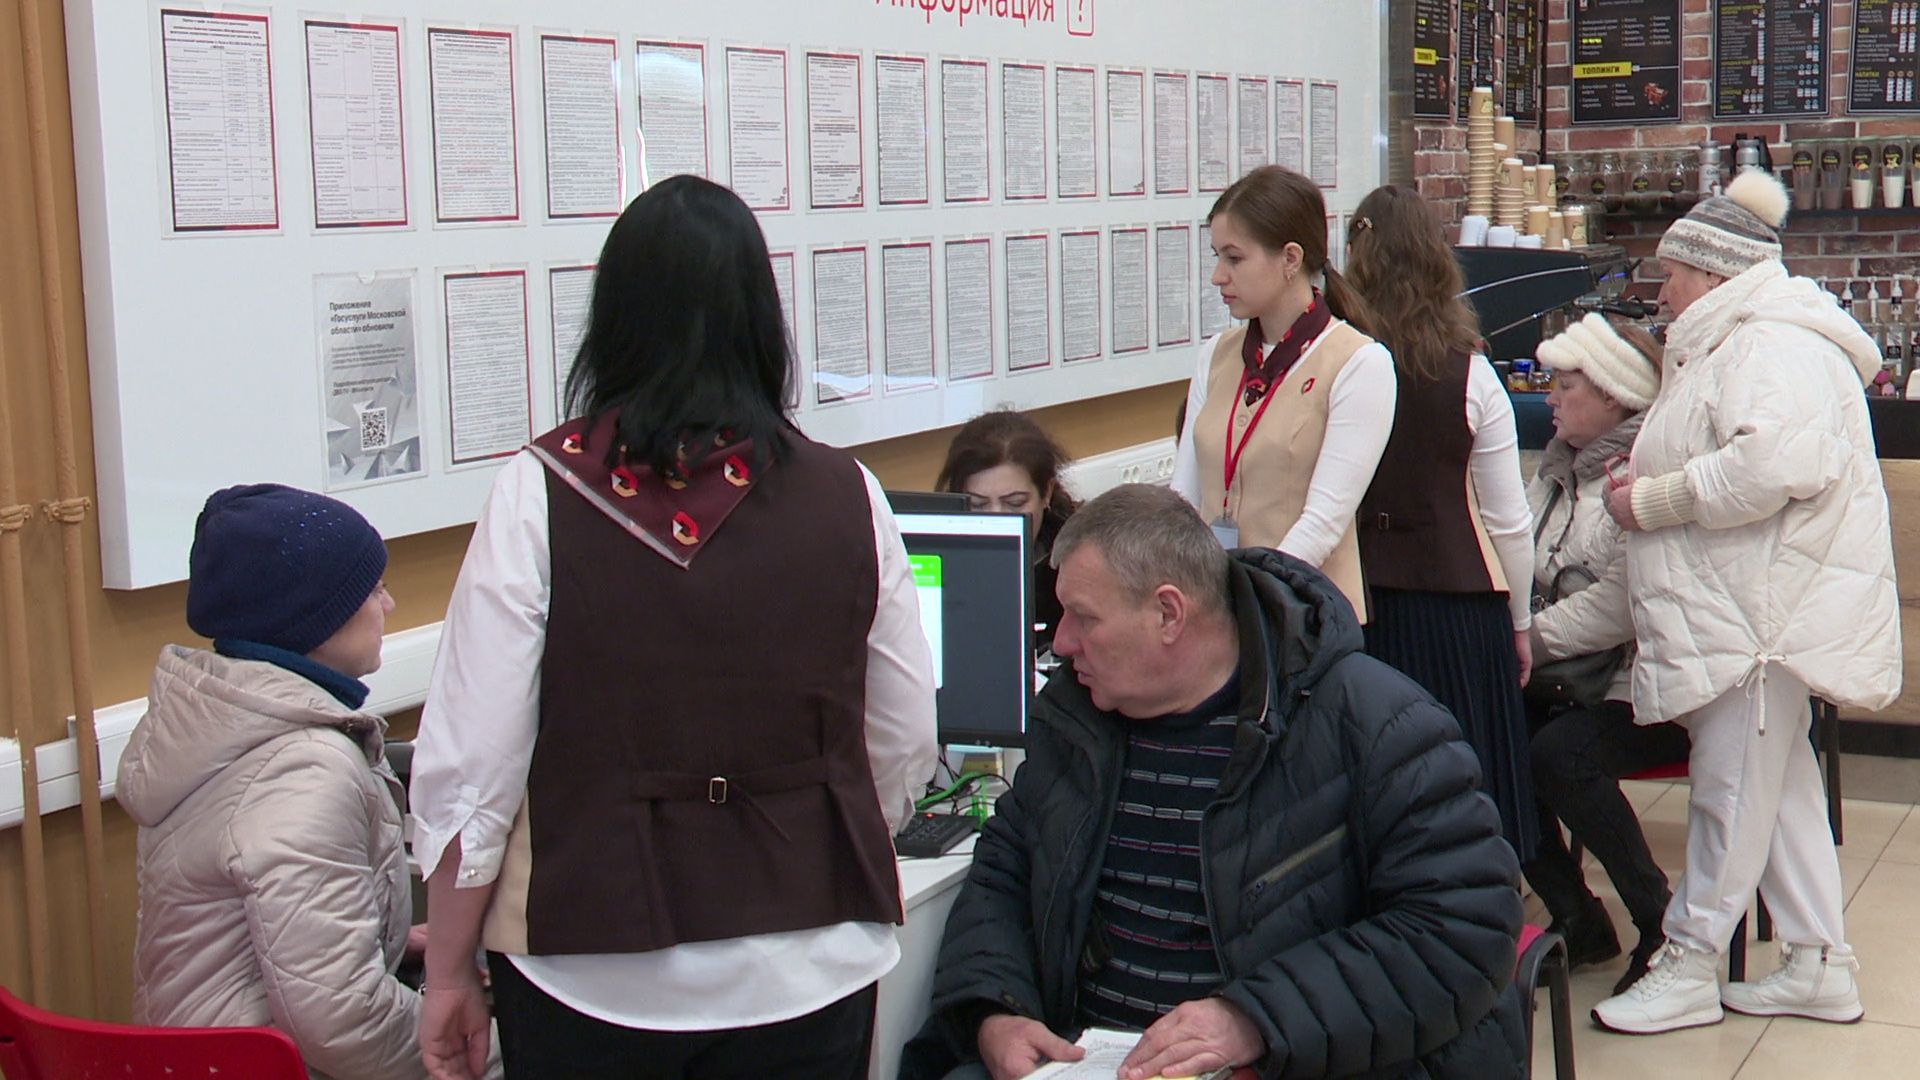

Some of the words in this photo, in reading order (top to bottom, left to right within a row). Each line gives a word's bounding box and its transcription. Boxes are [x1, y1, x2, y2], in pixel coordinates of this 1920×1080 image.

[876, 0, 1055, 27] формация
[1582, 66, 1620, 75] ТОППИНГИ
[330, 301, 371, 312] Приложение
[330, 314, 366, 323] «Госуслуги
[367, 308, 406, 318] Московской
[362, 323, 394, 332] обновили
